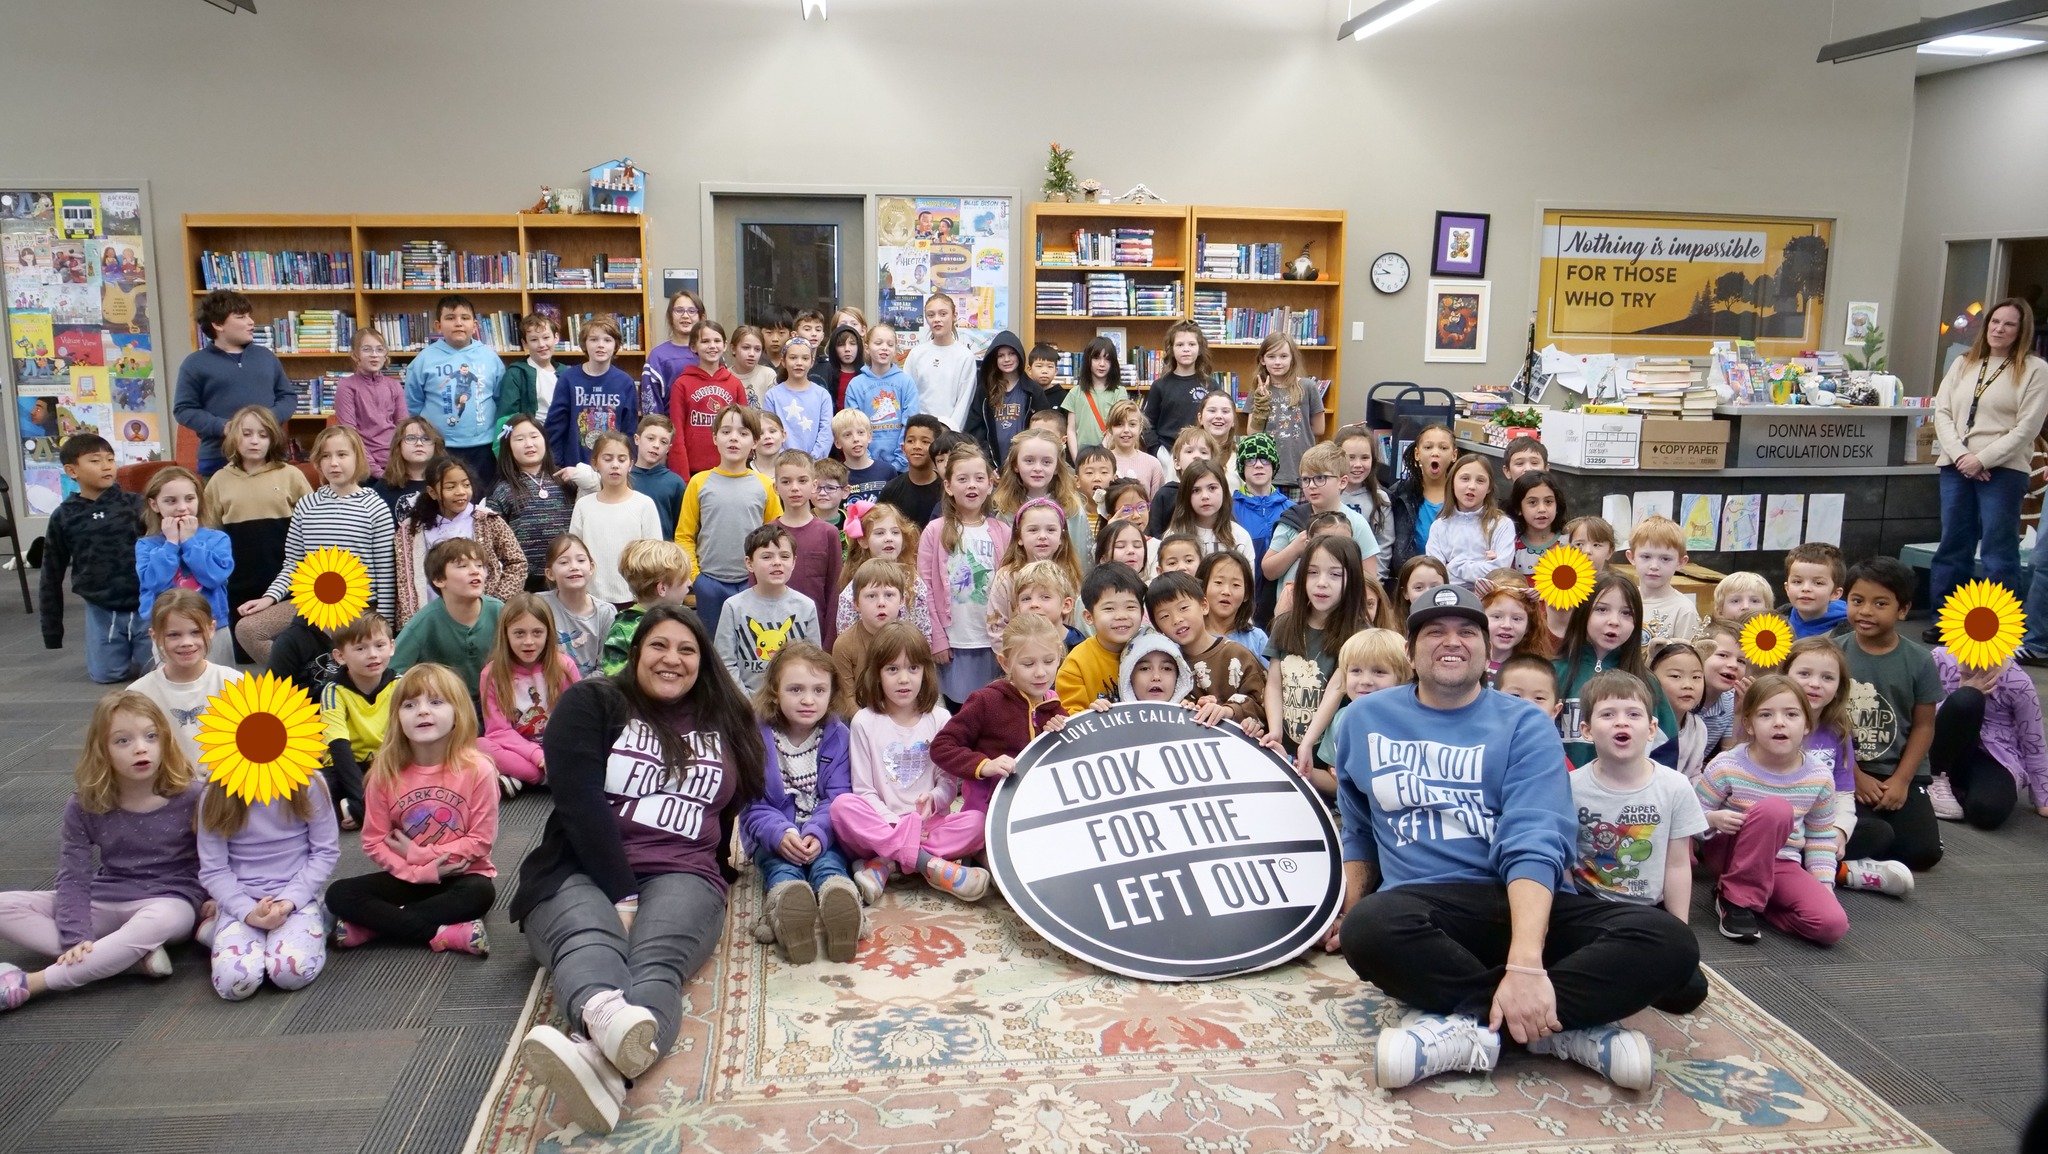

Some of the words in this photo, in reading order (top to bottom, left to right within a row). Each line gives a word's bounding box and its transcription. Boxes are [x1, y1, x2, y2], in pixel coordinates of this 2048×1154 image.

[1563, 230, 1648, 265] Nothing
[1650, 237, 1665, 255] is
[1667, 237, 1763, 263] impossible
[1566, 265, 1606, 283] FOR
[1614, 266, 1677, 284] THOSE
[1565, 290, 1614, 308] WHO
[1622, 292, 1657, 309] TRY
[435, 363, 453, 377] 10
[575, 386, 621, 408] BEATLES
[691, 410, 718, 426] CARD
[1768, 424, 1817, 438] DONNA
[1820, 424, 1866, 438] SEWELL
[1659, 444, 1686, 455] COPY
[1687, 445, 1719, 455] PAPER
[1756, 444, 1840, 459] CIRCULATION
[1842, 444, 1874, 458] DESK
[1060, 720, 1098, 744] LOVE
[1099, 710, 1134, 729] LIKE
[1139, 709, 1186, 725] CALLA
[1376, 735, 1431, 778] LOOK
[1437, 746, 1482, 781] OUT
[1050, 749, 1154, 806] LOOK
[1160, 741, 1231, 787] OUT
[398, 788, 432, 810] PARK
[435, 789, 464, 807] CITY
[1623, 805, 1658, 814] SUPER
[656, 797, 702, 835] OUT
[1387, 807, 1437, 847] LEFT
[1616, 813, 1662, 825] MARIO
[1086, 810, 1166, 862] FOR
[1170, 799, 1251, 847] THE
[1093, 869, 1193, 931] LEFT
